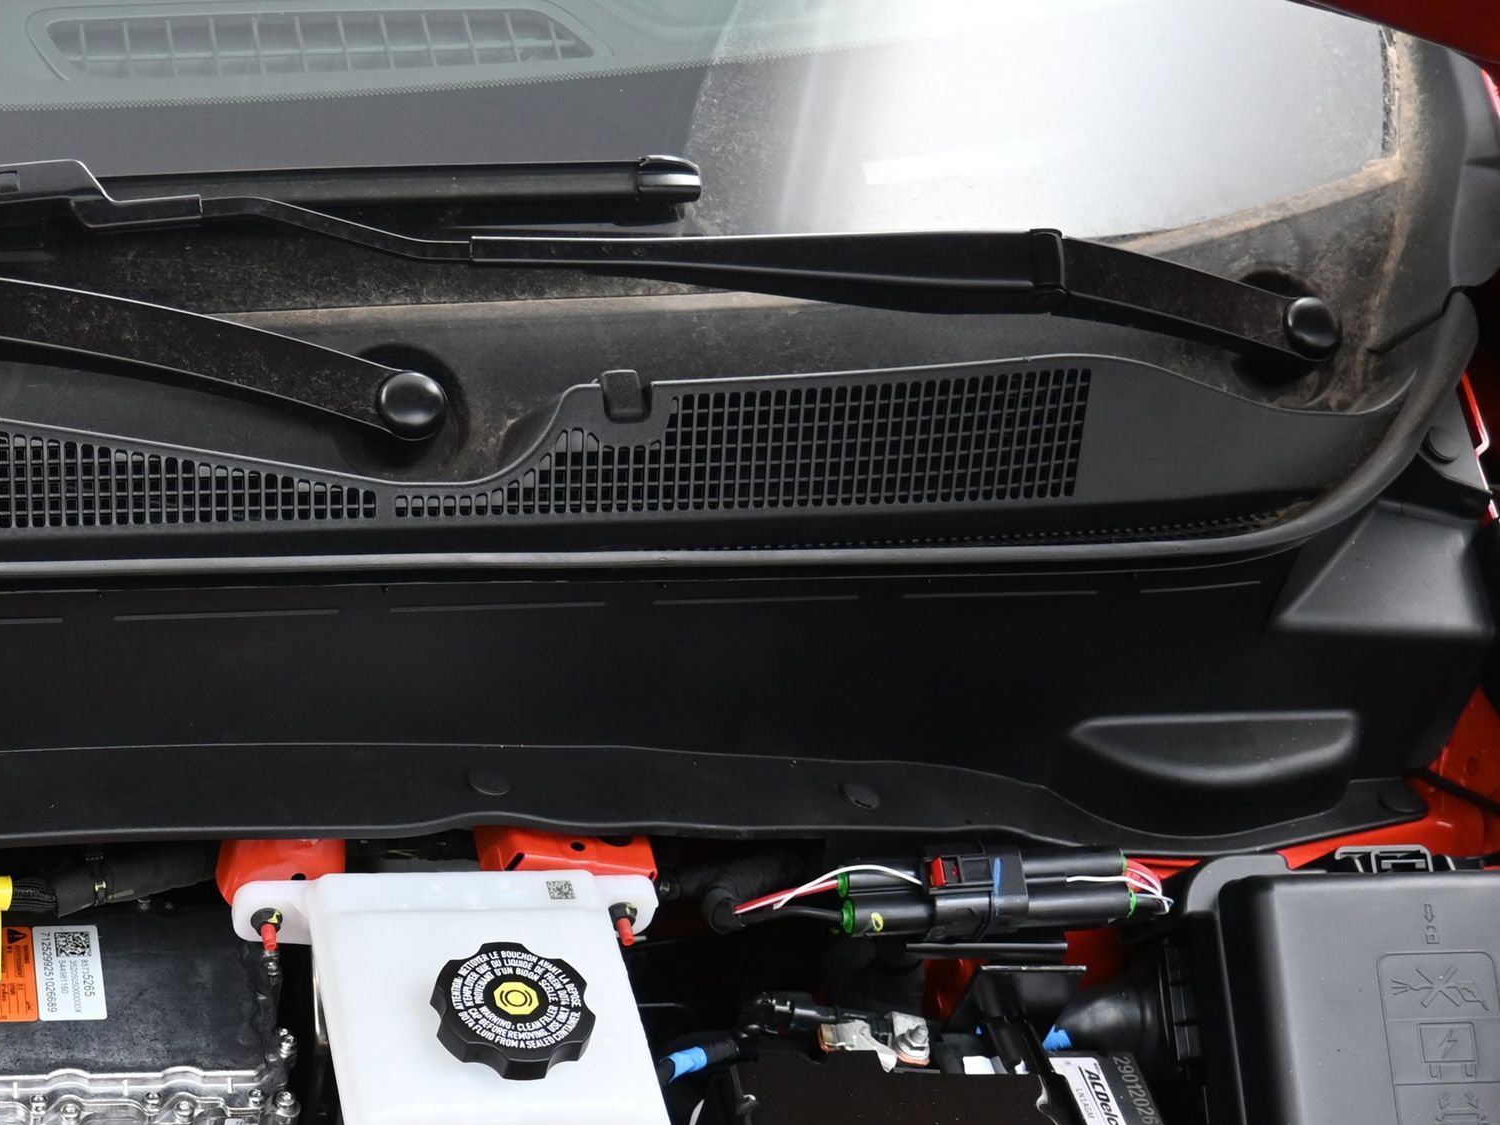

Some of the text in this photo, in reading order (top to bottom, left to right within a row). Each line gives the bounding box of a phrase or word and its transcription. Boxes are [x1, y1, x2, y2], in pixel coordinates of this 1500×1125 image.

[457, 954, 490, 977] NETTOYER
[488, 951, 500, 960] LE
[501, 951, 538, 963] BOUCHON
[538, 960, 563, 976] AVANT
[558, 974, 571, 985] LA
[565, 983, 581, 1008] DEPOSE
[474, 967, 559, 1005] PROVENANT D'UN BIDON SCELLE
[475, 963, 492, 975] QUE
[490, 959, 503, 969] DU
[504, 959, 534, 971] LIQUIDE
[534, 966, 546, 976] DE
[543, 972, 564, 990] FREIN
[557, 990, 571, 1006] DOT4
[457, 1011, 477, 1028] DOT4
[471, 1024, 496, 1041] FLUID
[494, 1035, 519, 1049] FROM
[519, 1040, 526, 1049] A
[525, 1036, 556, 1049] SEALED
[467, 1008, 483, 1020] CAP
[478, 1017, 508, 1038] BEFORE
[546, 1020, 563, 1033] USE
[556, 1006, 570, 1024] ONLY
[478, 1005, 559, 1032] WARNING: CLEAN FILLER
[1075, 1088, 1095, 1120] LN1AGM
